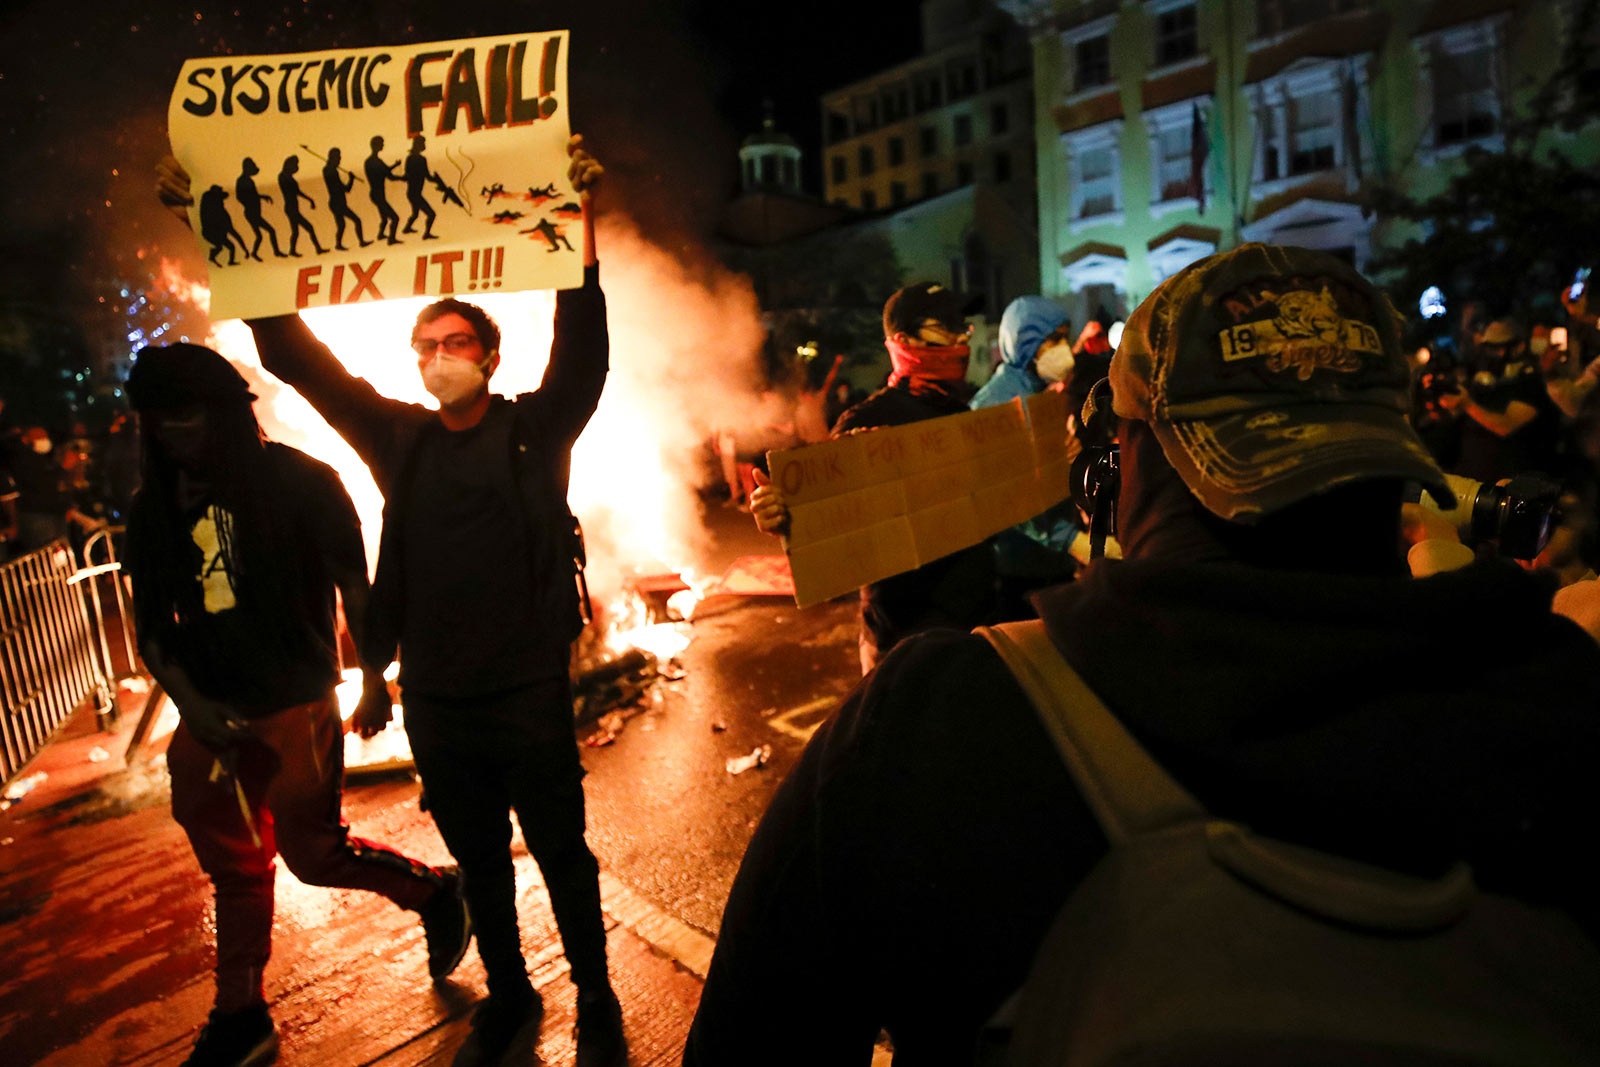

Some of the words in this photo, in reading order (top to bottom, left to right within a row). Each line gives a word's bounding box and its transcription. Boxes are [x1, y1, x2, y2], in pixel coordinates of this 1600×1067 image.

[182, 54, 392, 117] SYSTEMIC
[404, 36, 561, 138] FAIL!
[295, 259, 385, 309] FIX
[413, 246, 505, 296] IT!!!
